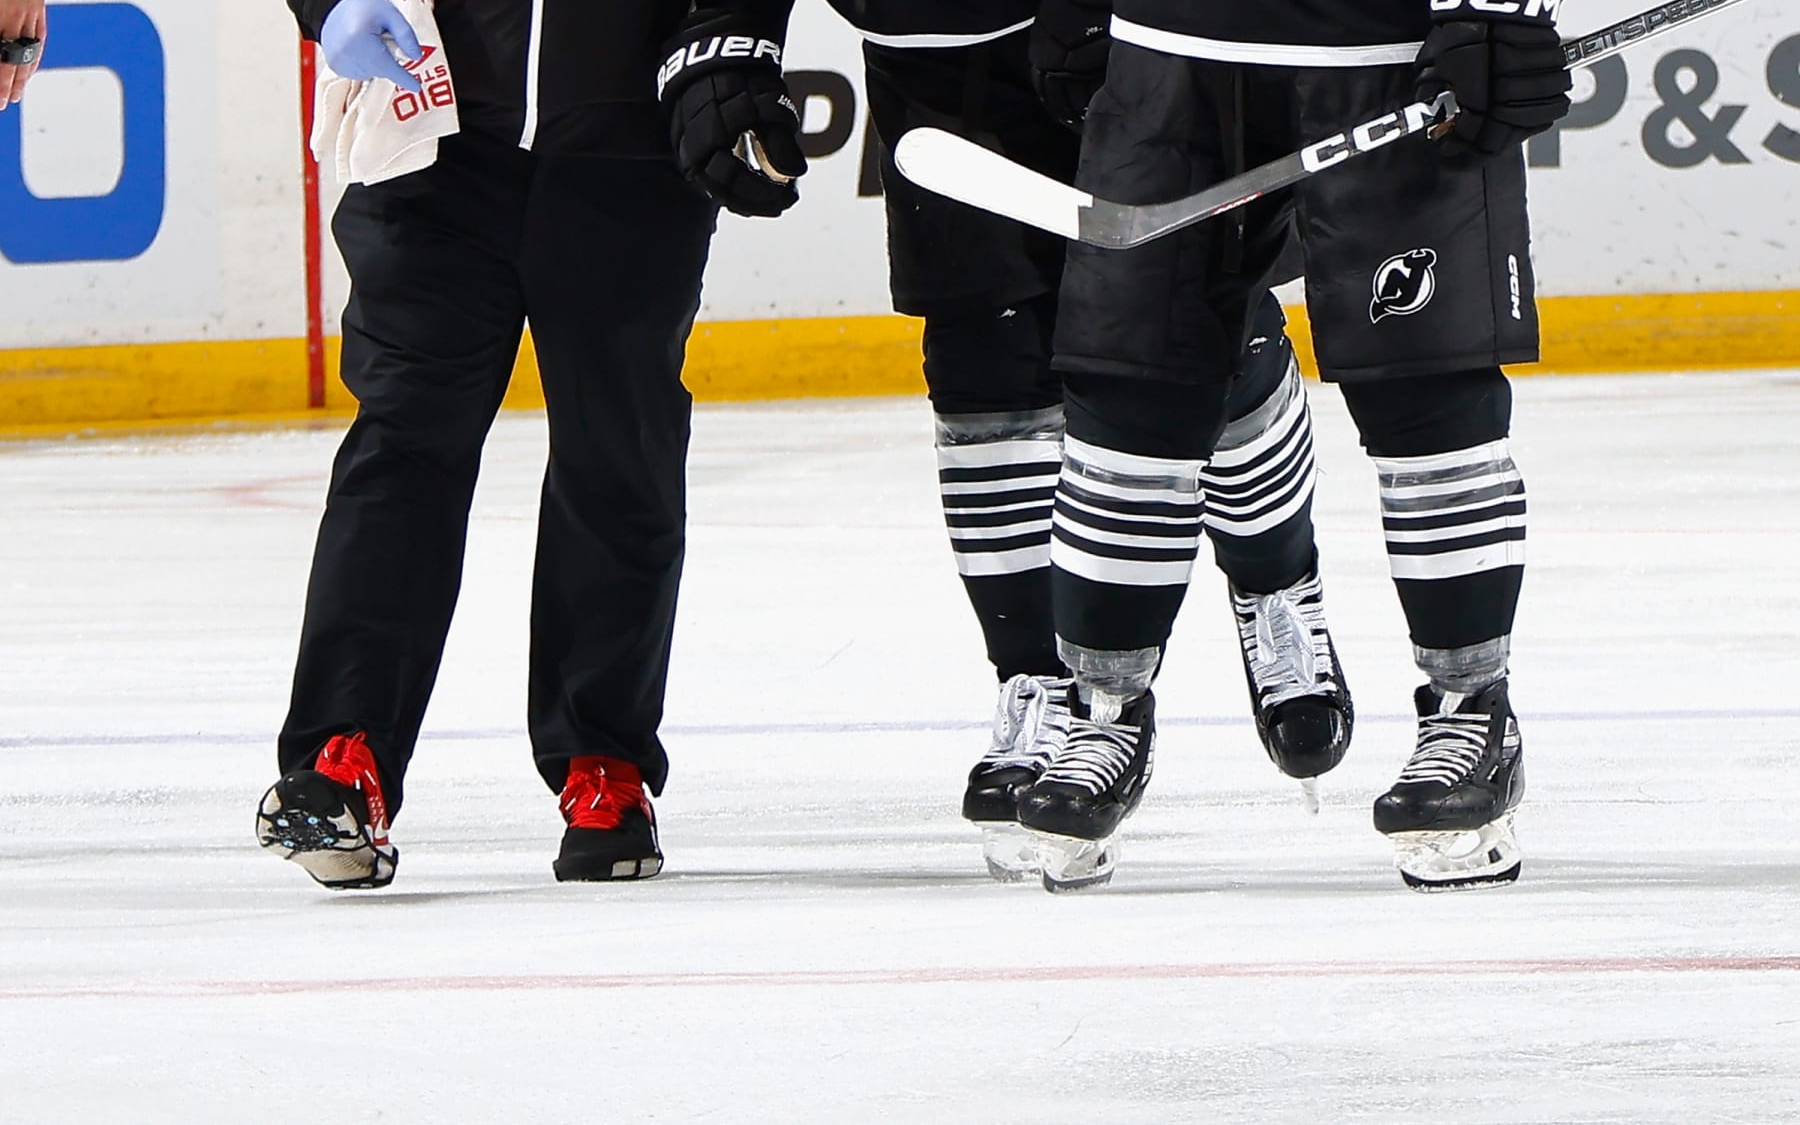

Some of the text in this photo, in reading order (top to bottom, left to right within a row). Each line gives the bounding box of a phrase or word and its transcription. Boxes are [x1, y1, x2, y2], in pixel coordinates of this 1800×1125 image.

[391, 79, 453, 122] BIO
[1300, 90, 1458, 173] CCM
[1508, 254, 1521, 320] CCM
